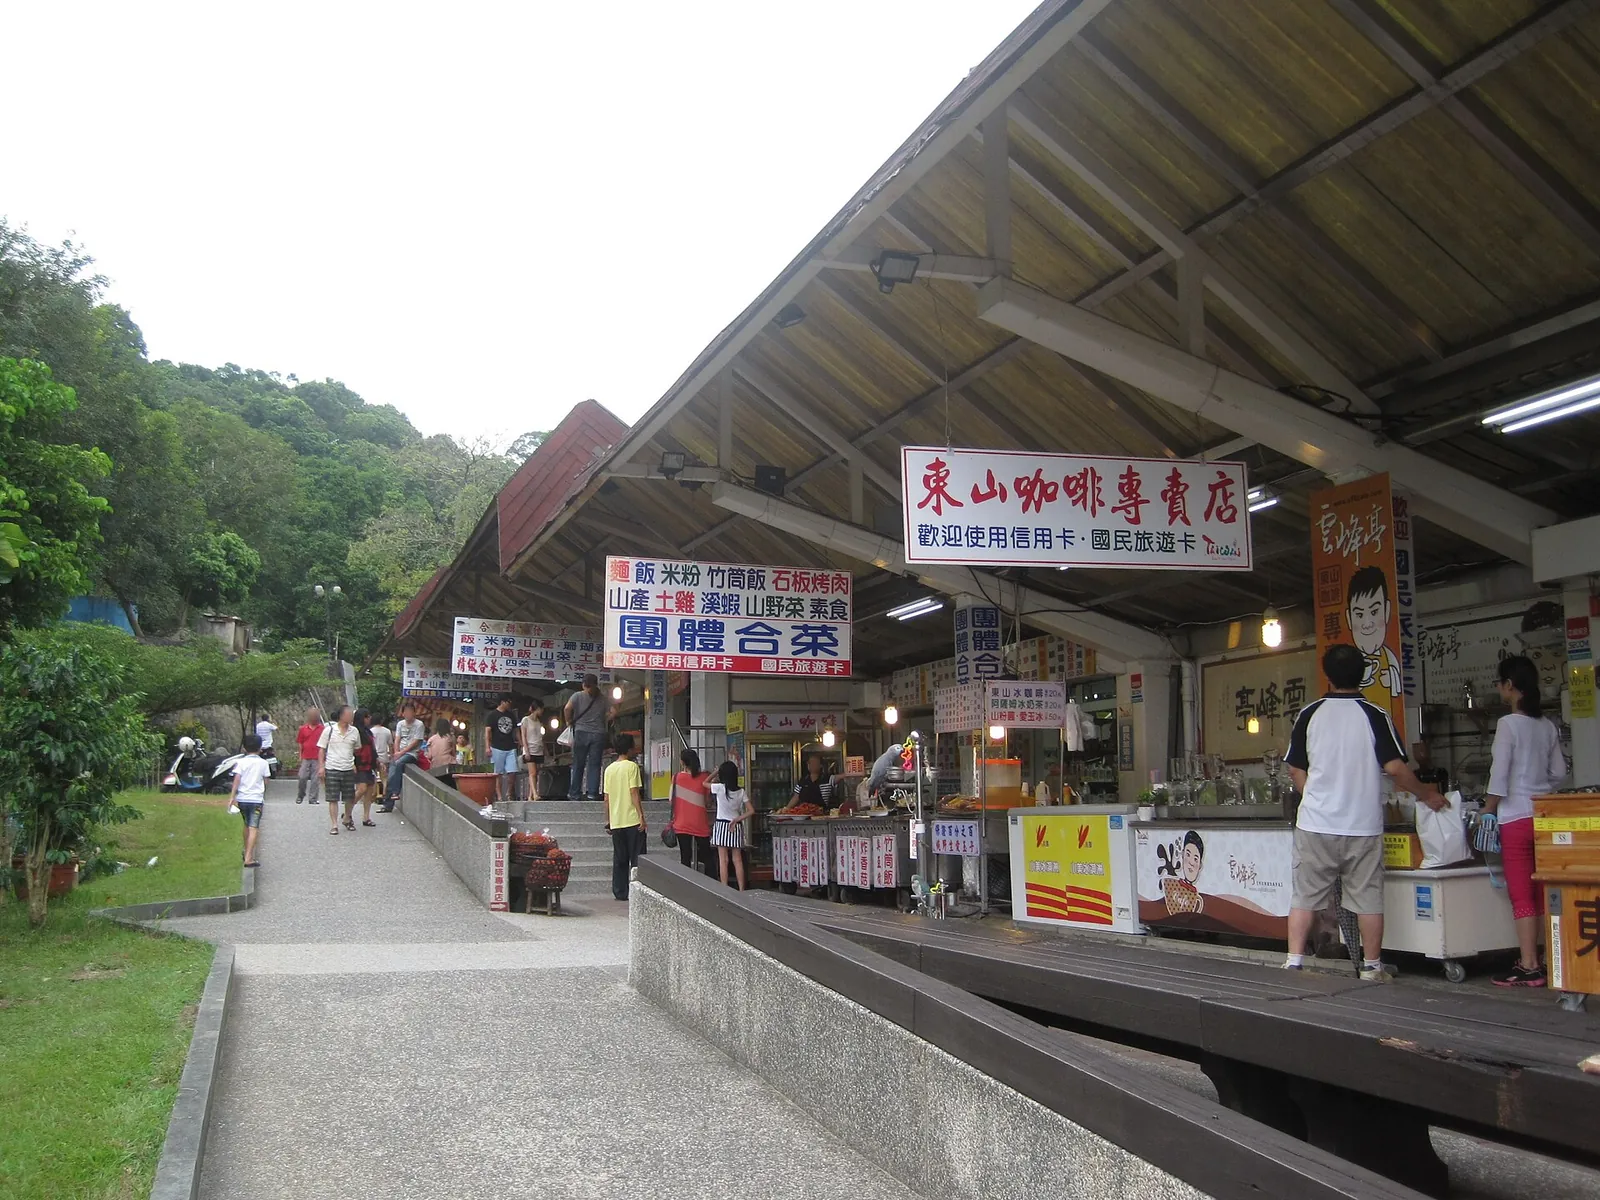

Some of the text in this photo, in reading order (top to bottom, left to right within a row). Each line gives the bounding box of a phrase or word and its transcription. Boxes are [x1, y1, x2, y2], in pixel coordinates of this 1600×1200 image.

[916, 456, 1238, 527] 東山咖啡專賣店
[609, 559, 849, 595] 麵 飯 米粉 竹筒飯 石板烤肉
[609, 587, 849, 621] 山產 土雞 溪蝦 山野菜 素食
[618, 614, 839, 657] 團體合菜
[972, 607, 1001, 680] 團體合
[612, 652, 845, 675] 歡迎使用信用卡 國民旅遊卡
[755, 713, 838, 732] 東山咖啡
[494, 842, 505, 902] 東山咖啡專賣店
[883, 835, 893, 885] 竹筒飯
